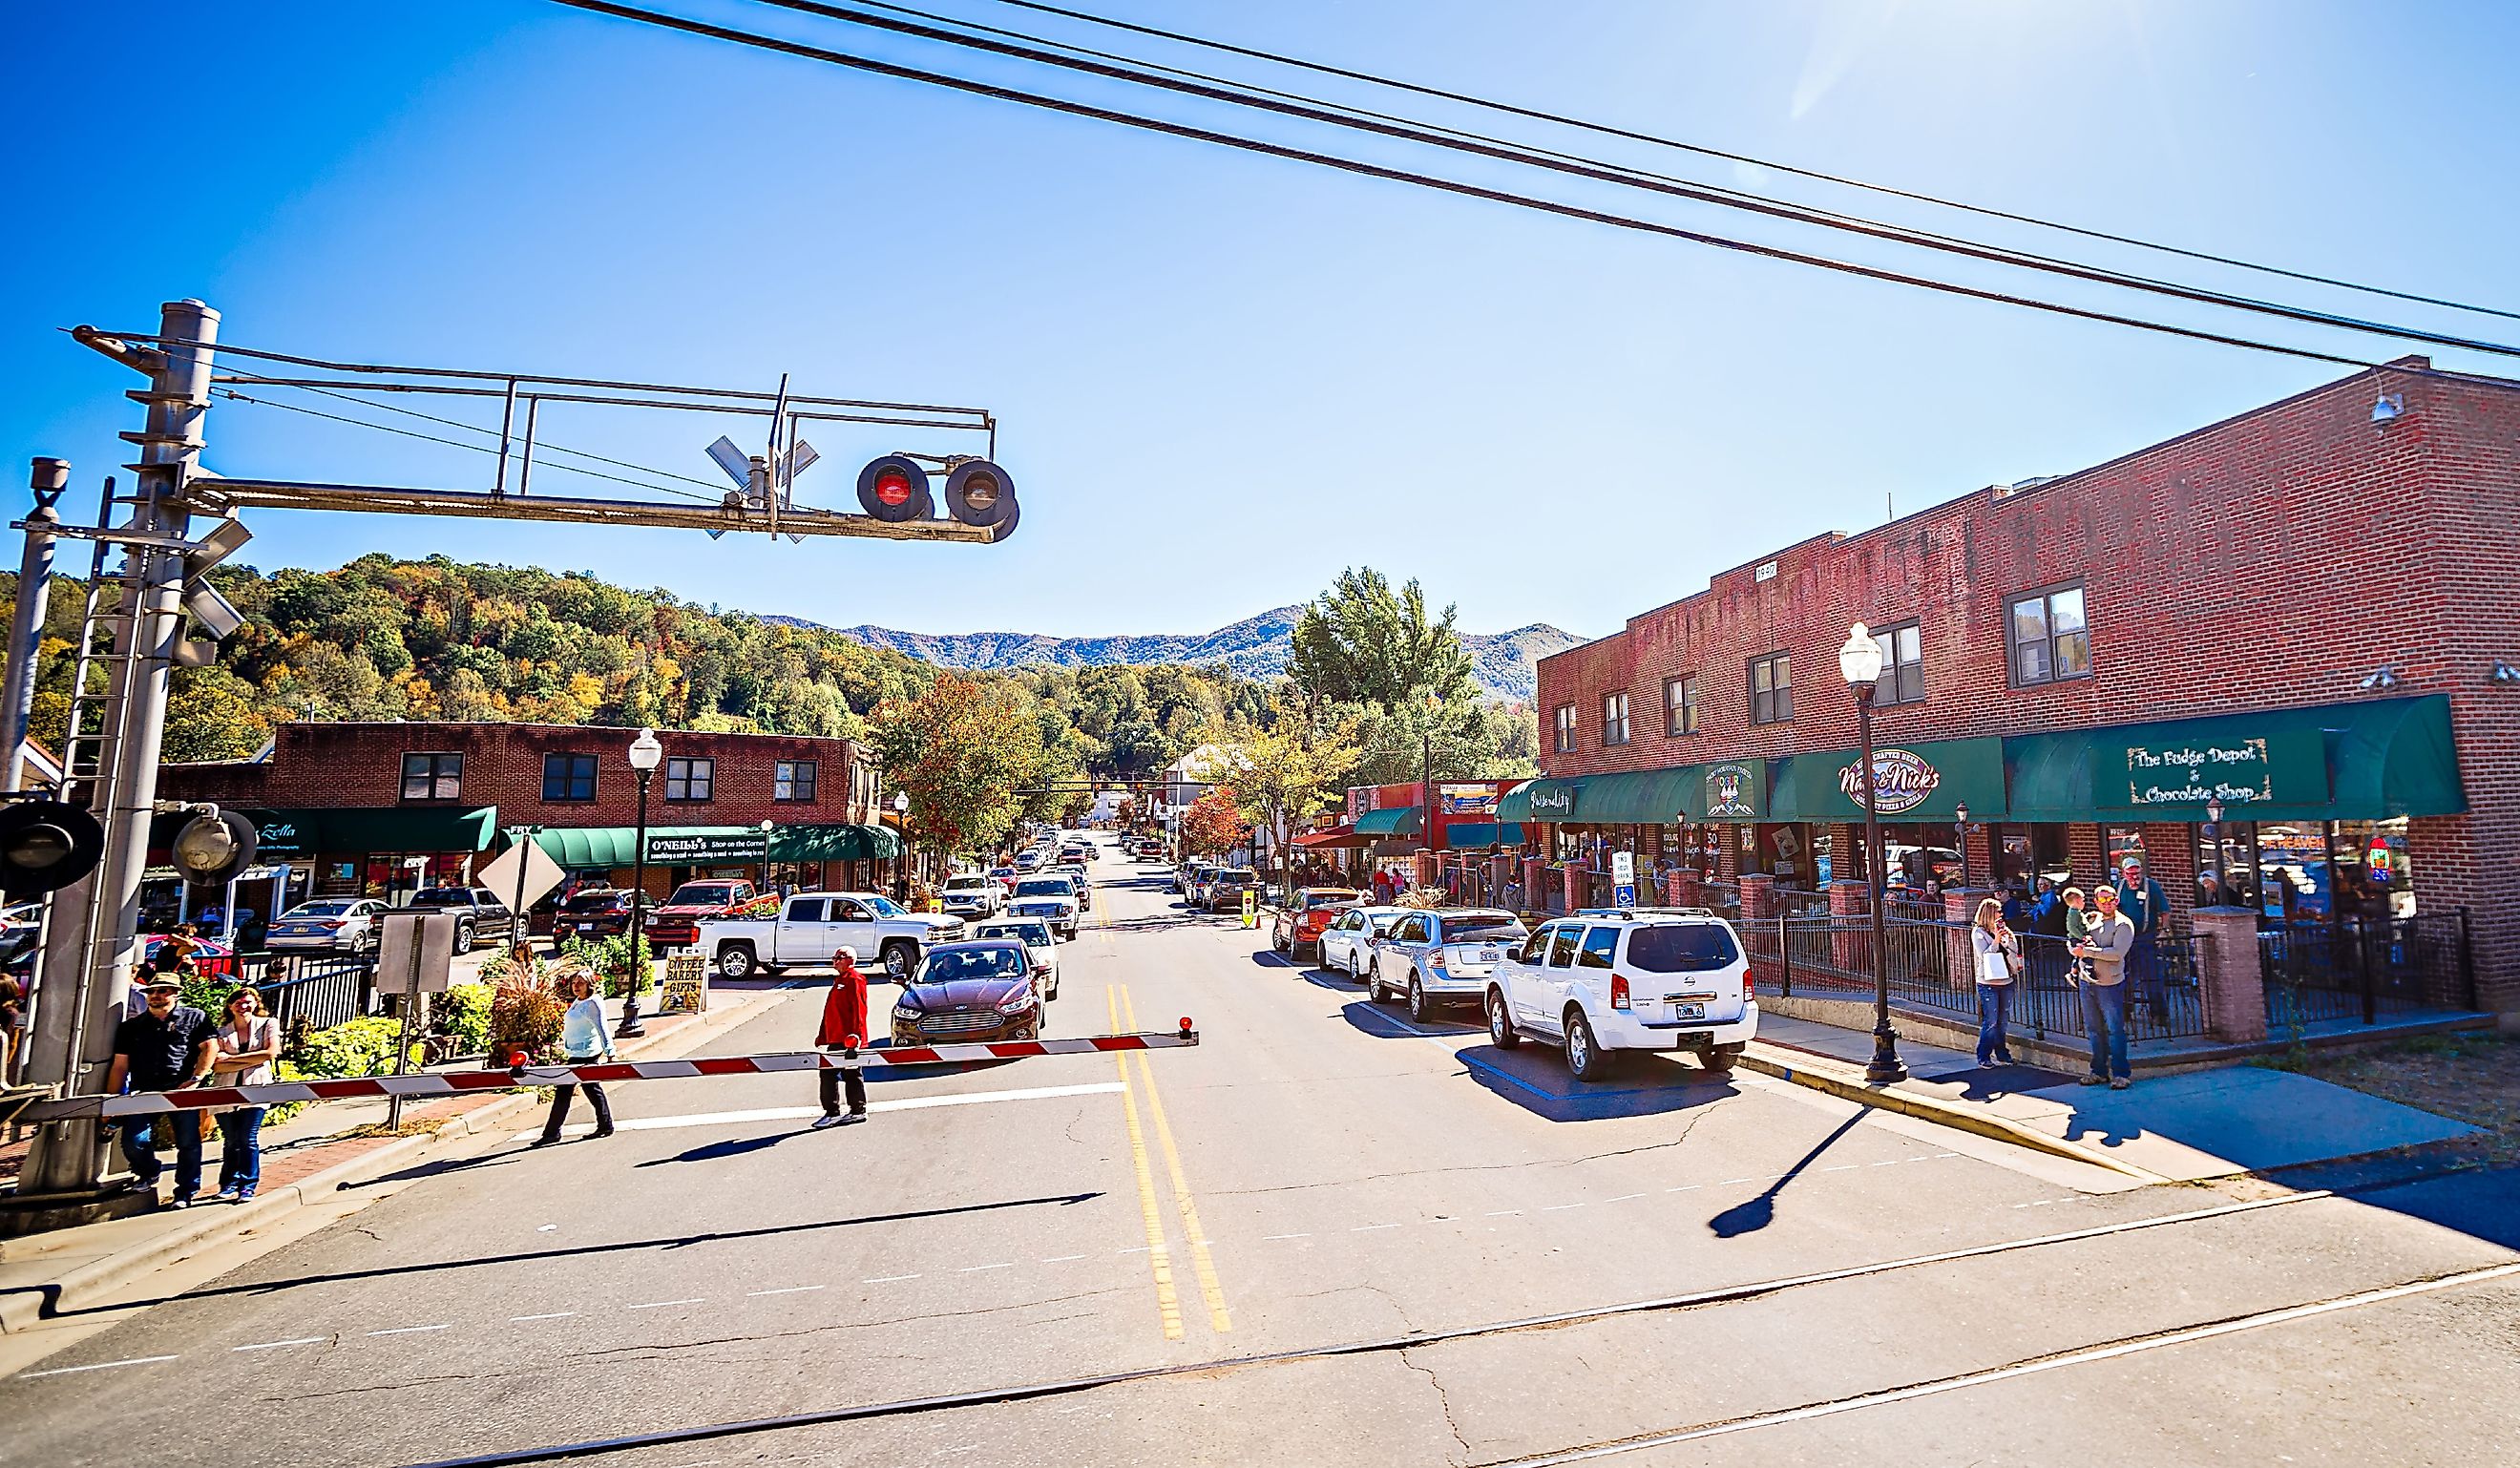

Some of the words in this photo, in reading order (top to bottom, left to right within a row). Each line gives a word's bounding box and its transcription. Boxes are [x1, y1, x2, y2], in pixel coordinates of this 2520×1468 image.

[1873, 752, 1900, 762] CRAFTED
[1901, 753, 1919, 765] BEER
[2134, 750, 2161, 766] The
[2163, 748, 2206, 767] Fudge
[2207, 745, 2257, 765] Depot
[1714, 774, 1742, 786] YOGURT
[1838, 766, 1876, 793] Na
[1878, 771, 1890, 787] &
[1886, 762, 1940, 791] Nick's
[2189, 769, 2199, 782] &
[2145, 785, 2212, 803] Chocolate
[2215, 783, 2255, 803] Shop
[1882, 802, 1899, 810] PIZZA
[1905, 793, 1923, 807] GRILL
[262, 823, 296, 840] Zella
[510, 826, 532, 834] FRY
[1707, 832, 1717, 844] 50
[668, 959, 704, 969] COFFEE
[666, 970, 704, 980] BAKERY
[669, 982, 697, 992] GIFTS
